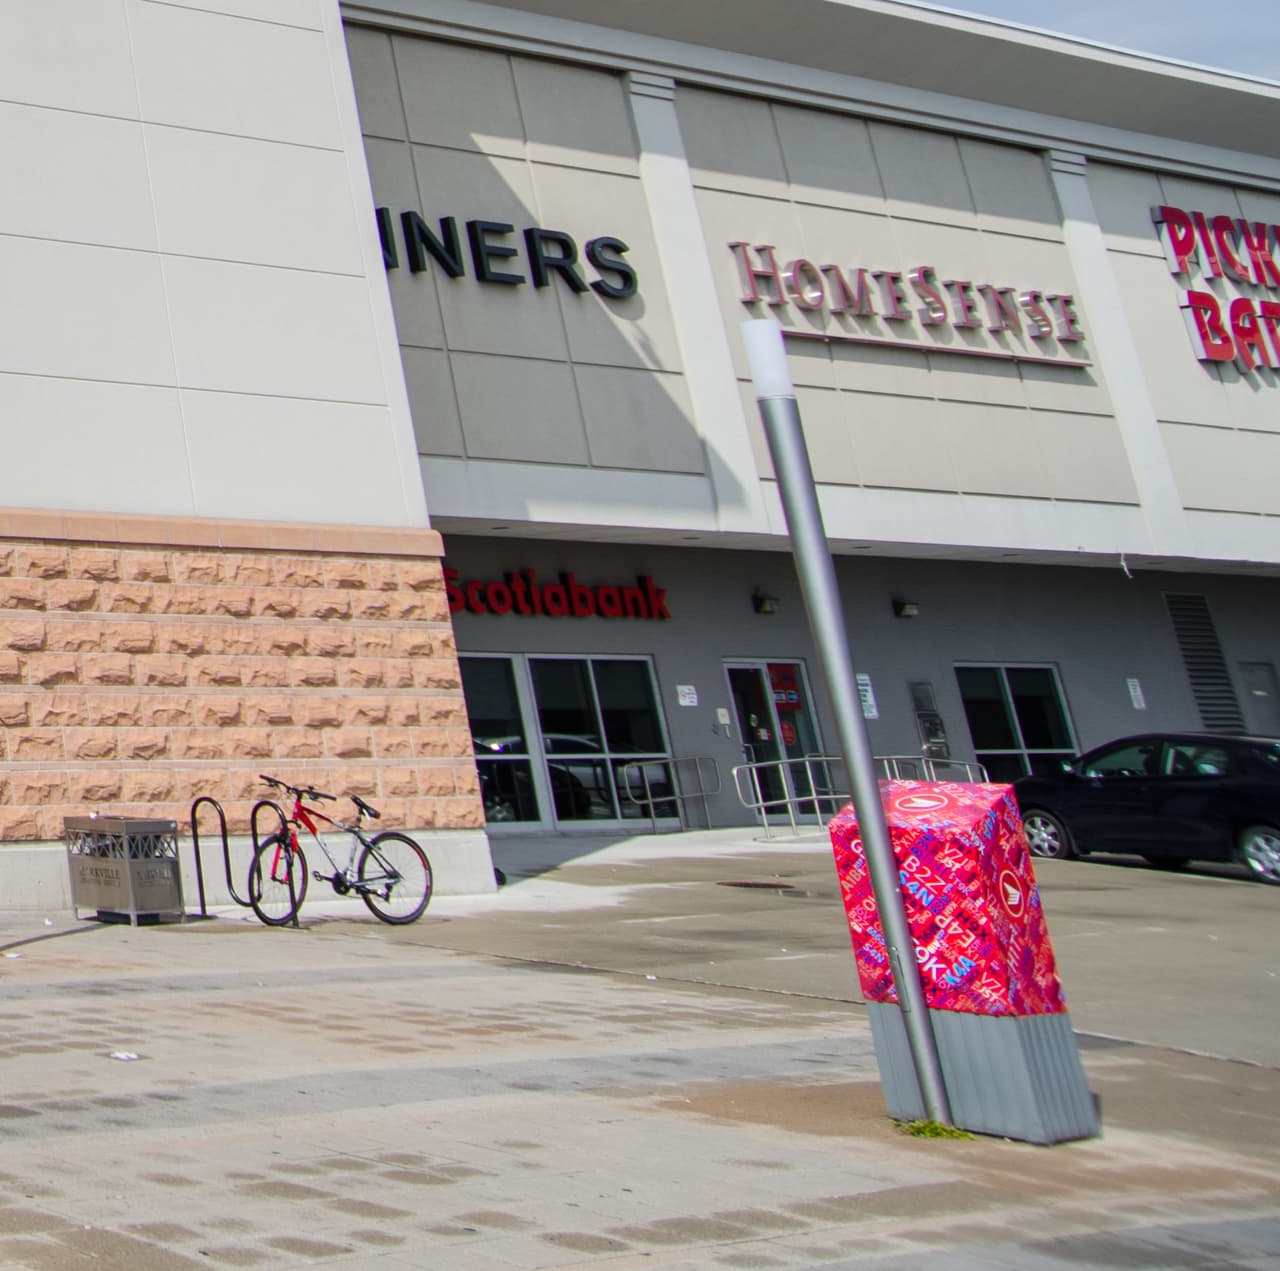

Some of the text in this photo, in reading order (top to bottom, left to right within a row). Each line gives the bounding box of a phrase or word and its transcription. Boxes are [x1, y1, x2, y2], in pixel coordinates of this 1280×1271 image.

[445, 568, 673, 619] Scotiabank
[903, 855, 947, 895] B2Z
[935, 915, 976, 948] E4P
[912, 936, 947, 981] 9K
